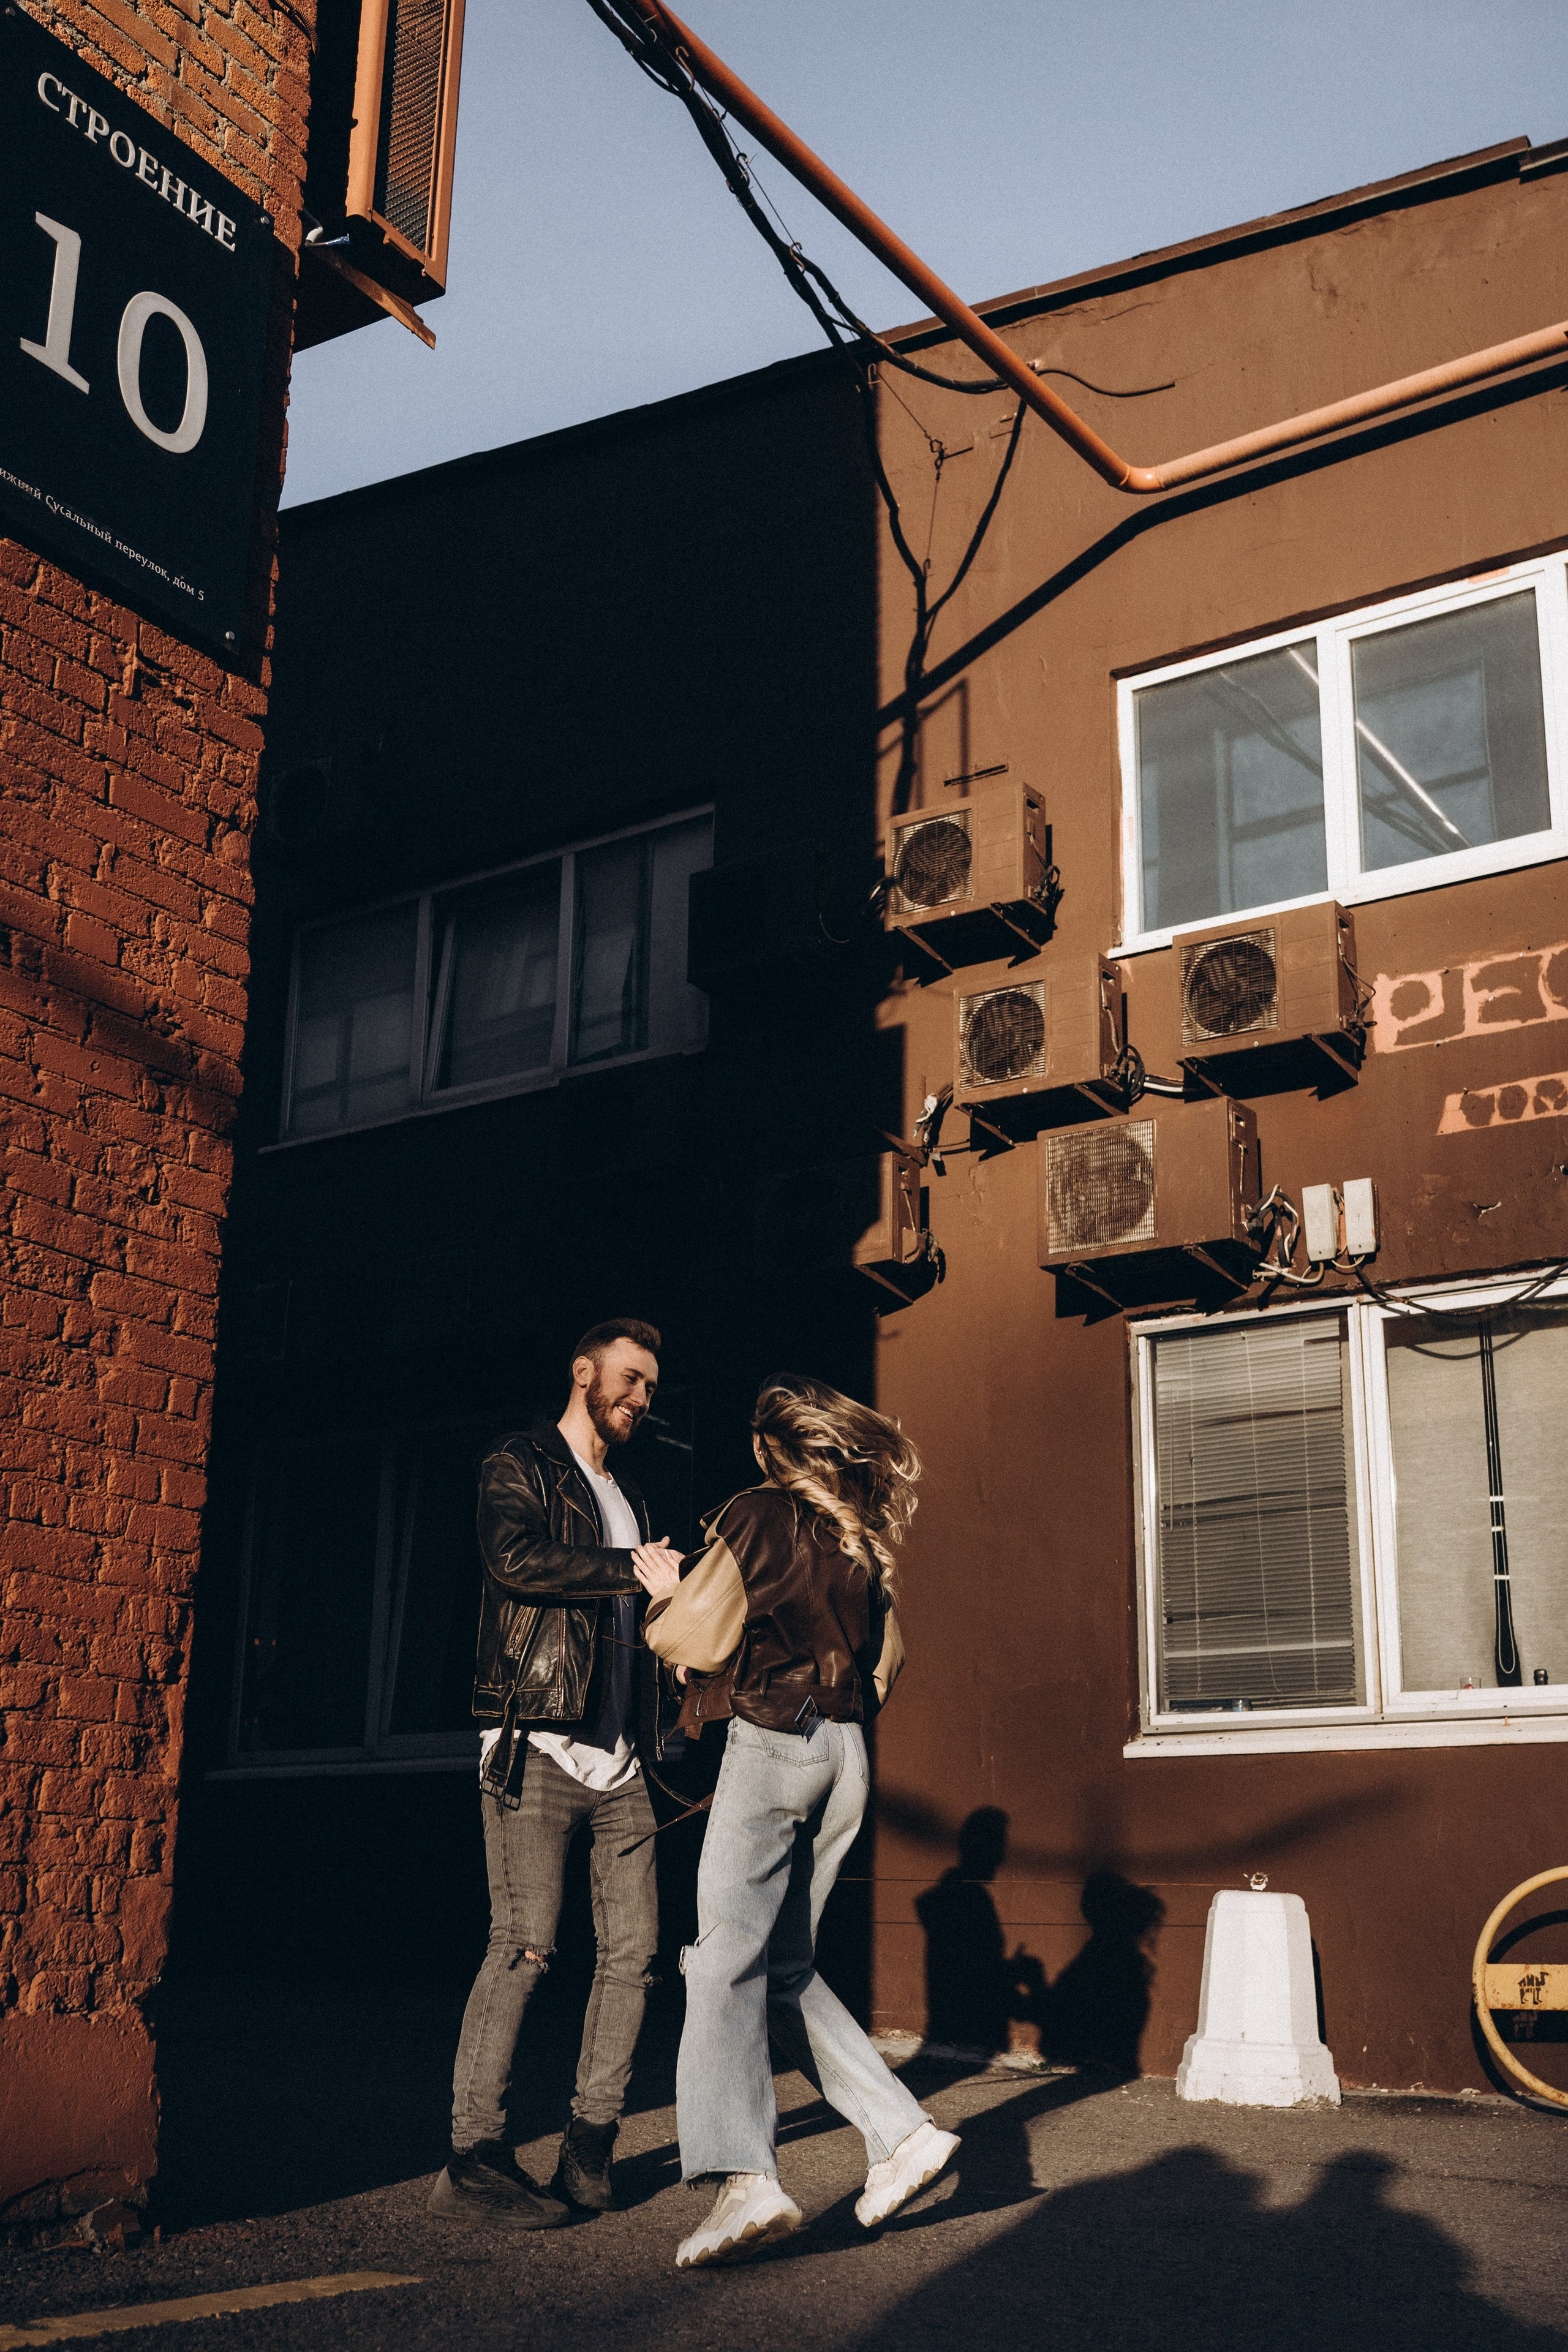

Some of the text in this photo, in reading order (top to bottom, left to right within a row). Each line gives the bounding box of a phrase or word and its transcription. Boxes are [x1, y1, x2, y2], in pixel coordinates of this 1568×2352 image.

[37, 72, 236, 252] СТРОЕНИЕ
[20, 211, 208, 454] 10
[45, 495, 111, 544] Сусальный
[115, 540, 170, 581] переулок,
[173, 576, 195, 596] дом
[198, 590, 205, 601] 5
